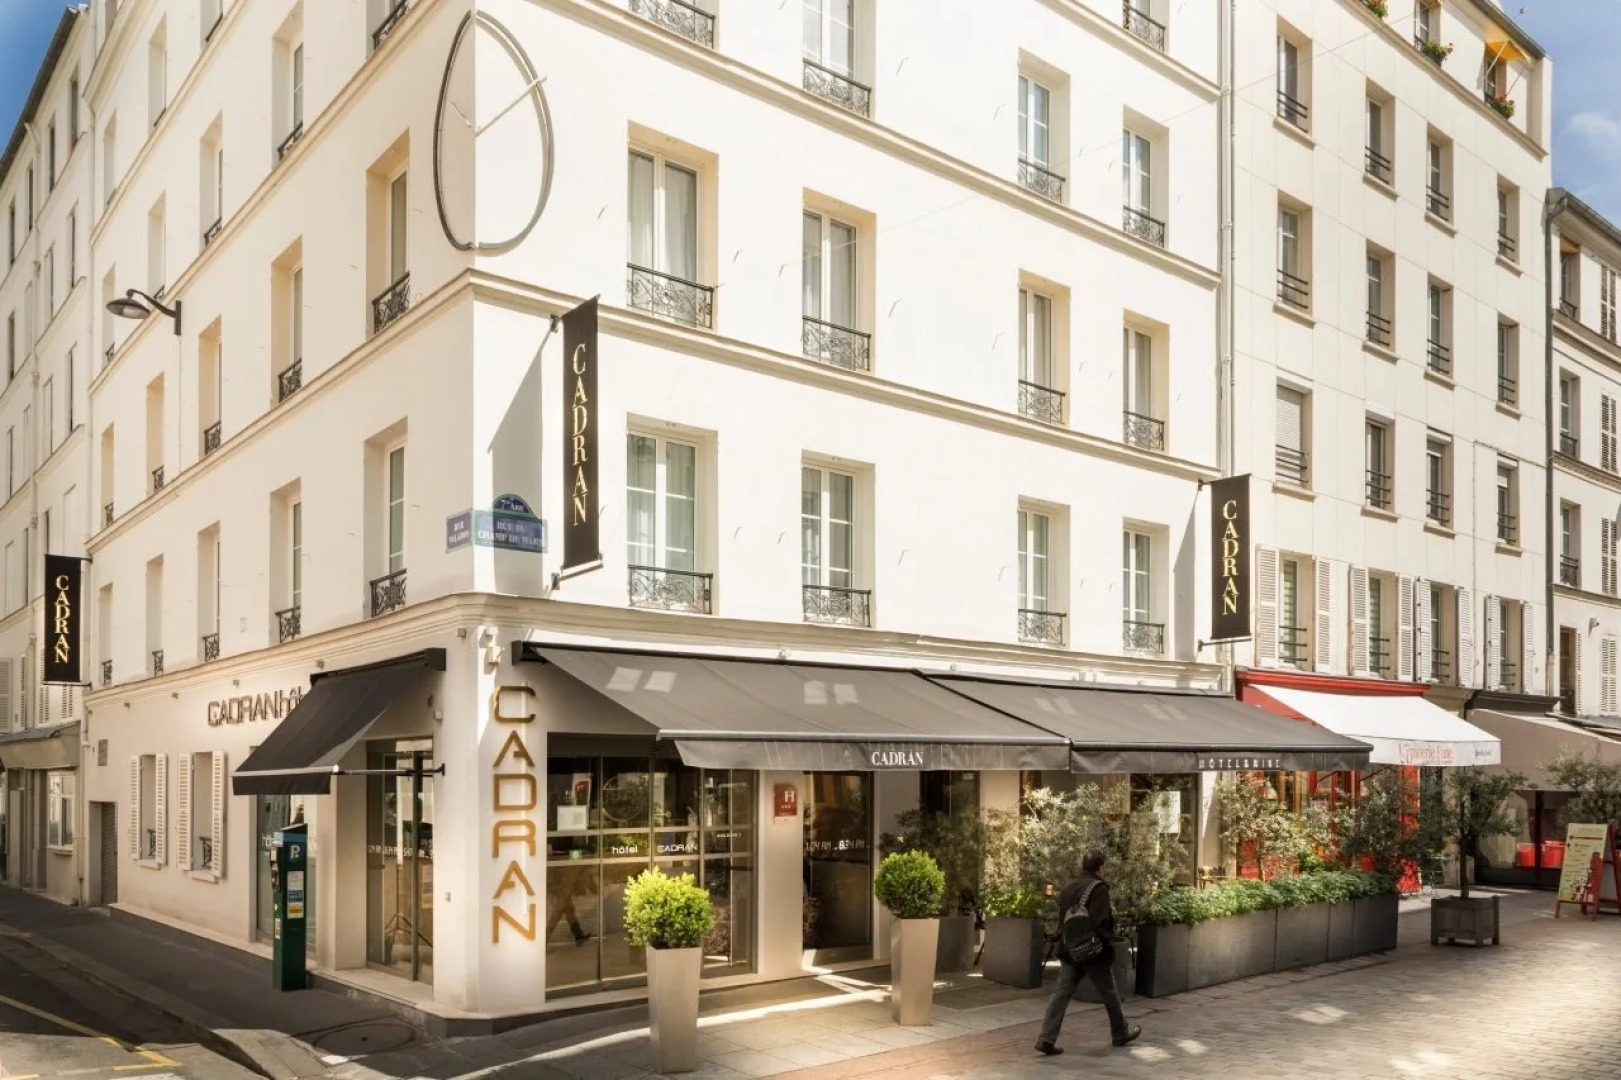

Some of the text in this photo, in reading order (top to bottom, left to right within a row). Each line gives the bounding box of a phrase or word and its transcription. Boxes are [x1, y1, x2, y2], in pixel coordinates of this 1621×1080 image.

[572, 344, 588, 527] CADRAN
[1222, 499, 1239, 616] CADRAN
[55, 574, 71, 663] CADRAN
[871, 750, 923, 766] CADRAN
[784, 790, 795, 802] H
[493, 686, 537, 943] CADRAN
[290, 845, 301, 859] P
[612, 845, 638, 855] hôtel
[657, 844, 698, 854] CADRAN
